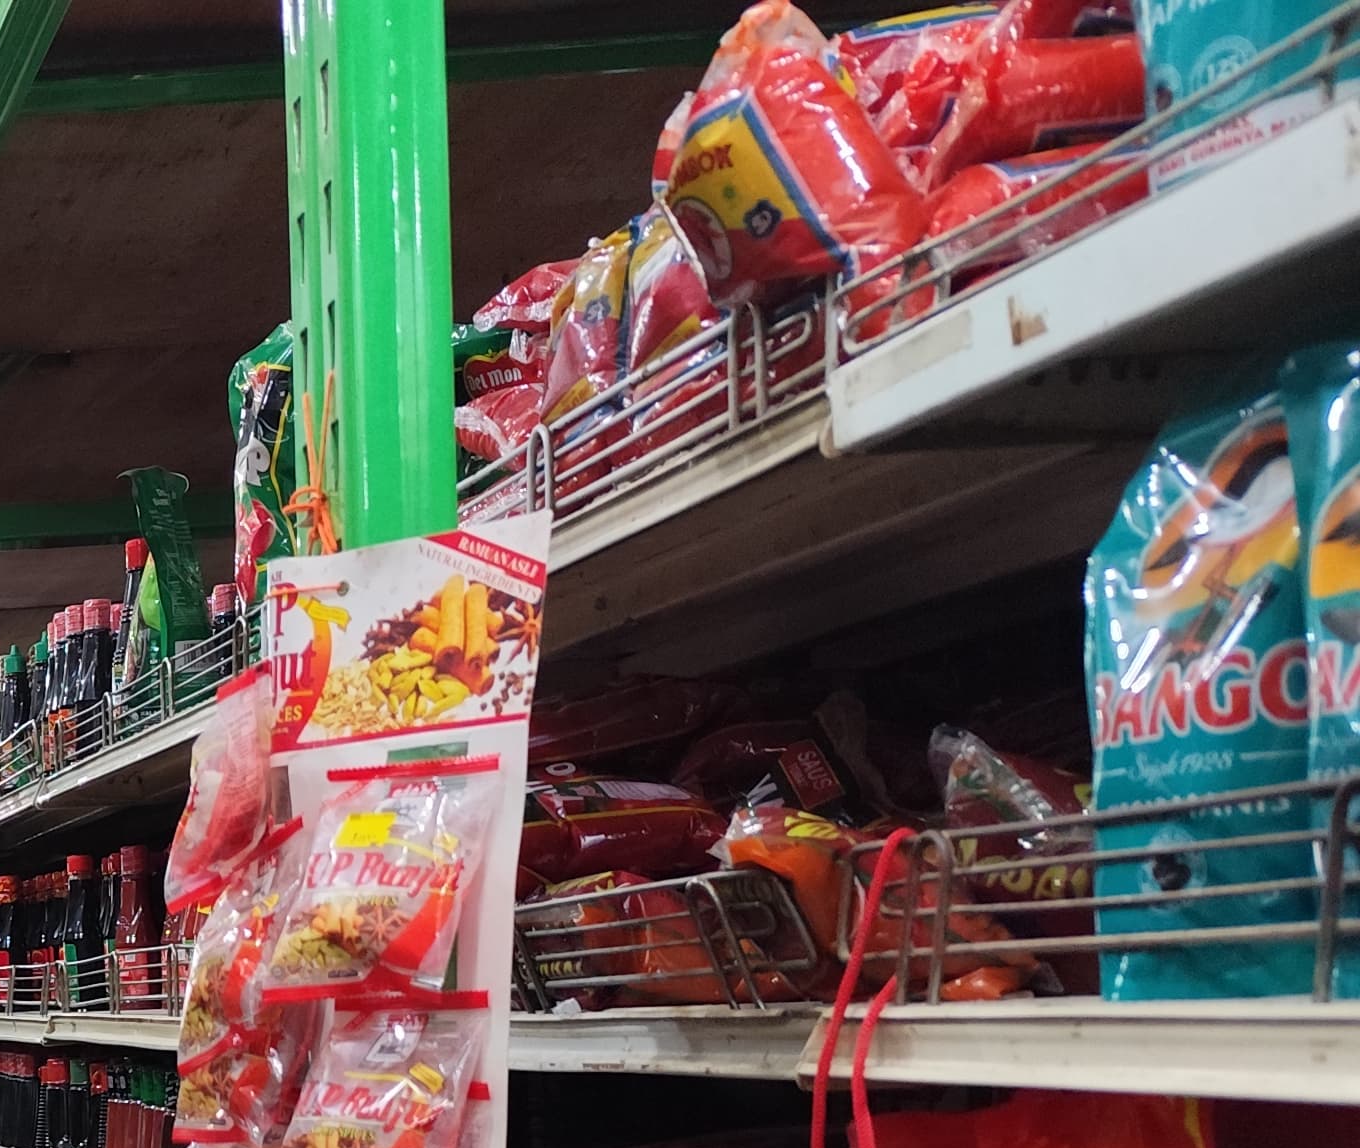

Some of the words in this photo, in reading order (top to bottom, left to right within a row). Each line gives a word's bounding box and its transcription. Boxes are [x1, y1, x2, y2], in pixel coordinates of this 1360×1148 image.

[487, 366, 523, 388] Mon
[458, 536, 508, 566] RAMUAN
[507, 554, 540, 578] ASLI
